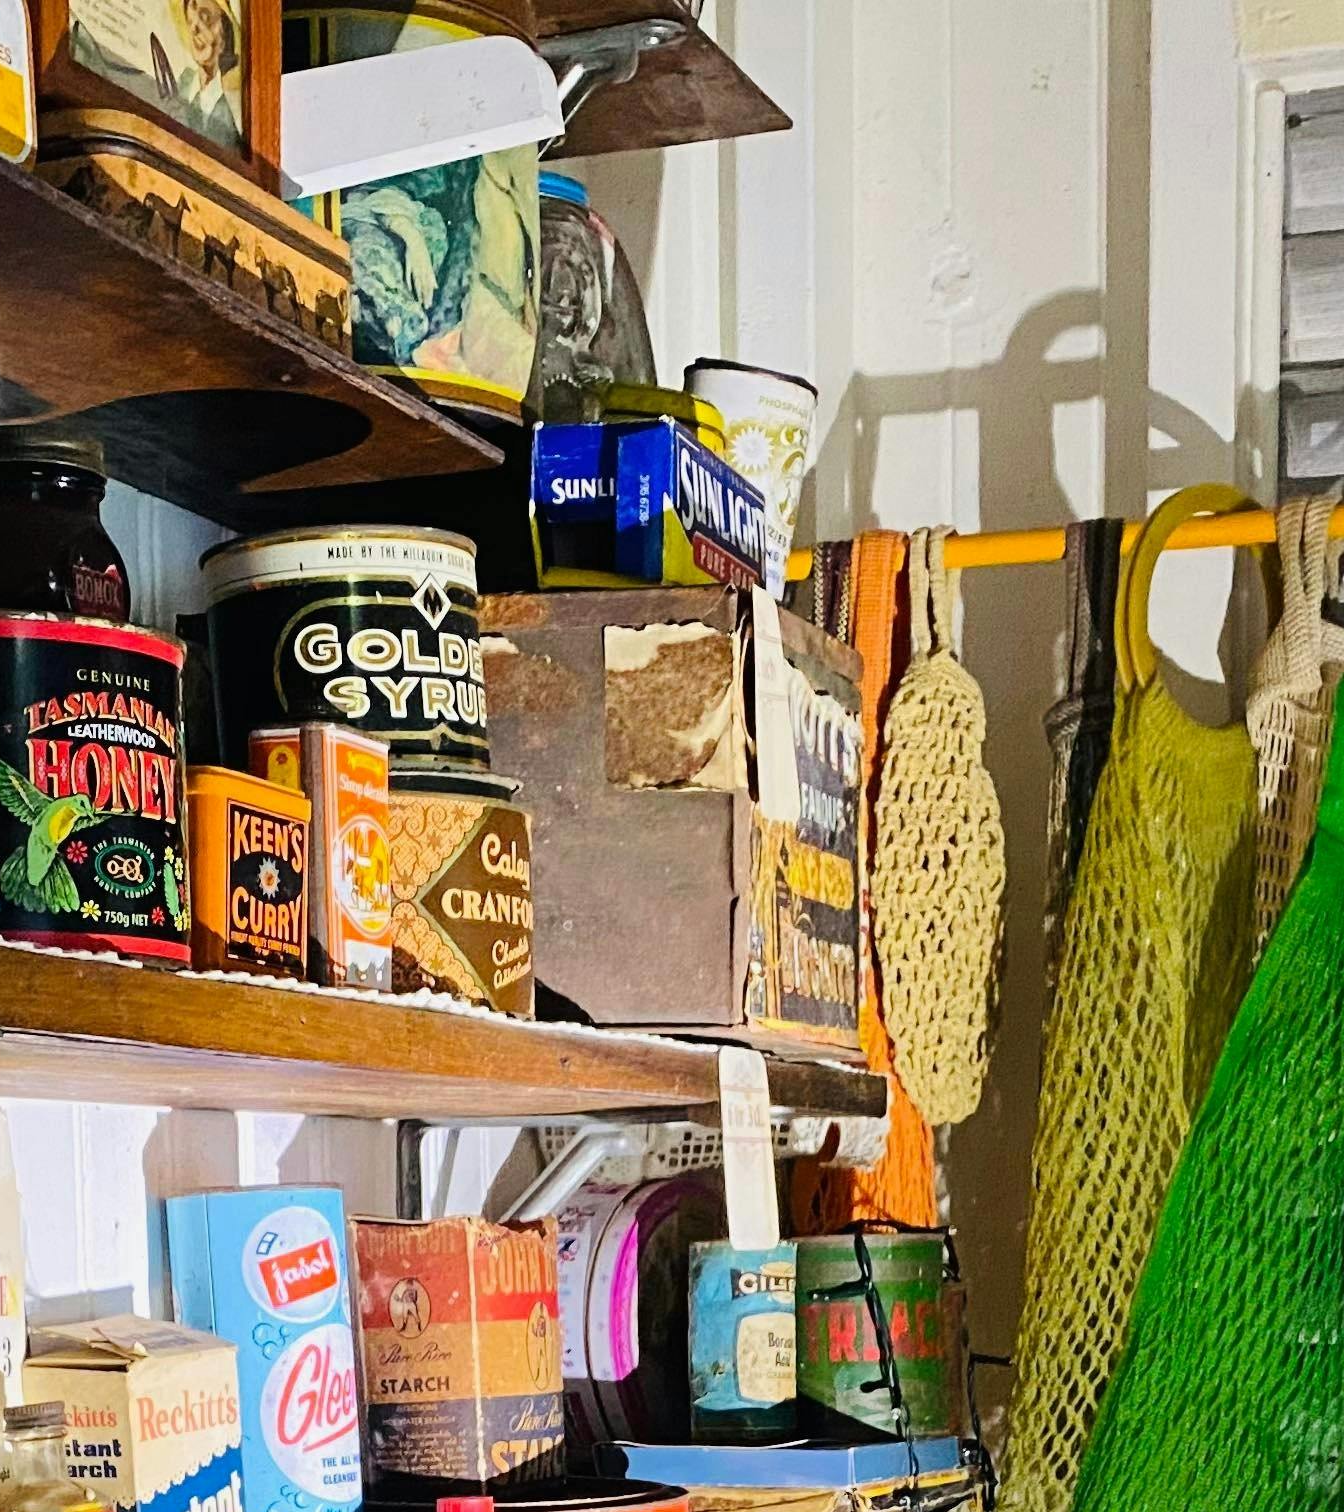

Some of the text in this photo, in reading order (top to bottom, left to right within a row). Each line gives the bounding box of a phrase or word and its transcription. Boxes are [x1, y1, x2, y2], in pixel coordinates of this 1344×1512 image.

[679, 447, 767, 574] SUNLIGHT
[327, 546, 354, 560] MADE
[361, 546, 373, 559] BY
[76, 668, 151, 692] GENUINE
[23, 691, 176, 754] TASMANIAN
[67, 723, 156, 749] LEATHERWOOD
[25, 738, 177, 825] HONEY
[232, 809, 304, 874] KEEN'S
[104, 910, 149, 928] 750g NET
[231, 885, 303, 944] CURRY
[379, 1375, 451, 1395] STARCH
[64, 1404, 118, 1428] ckitt's
[137, 1383, 239, 1442] Reckitt's
[321, 1457, 337, 1469] THE
